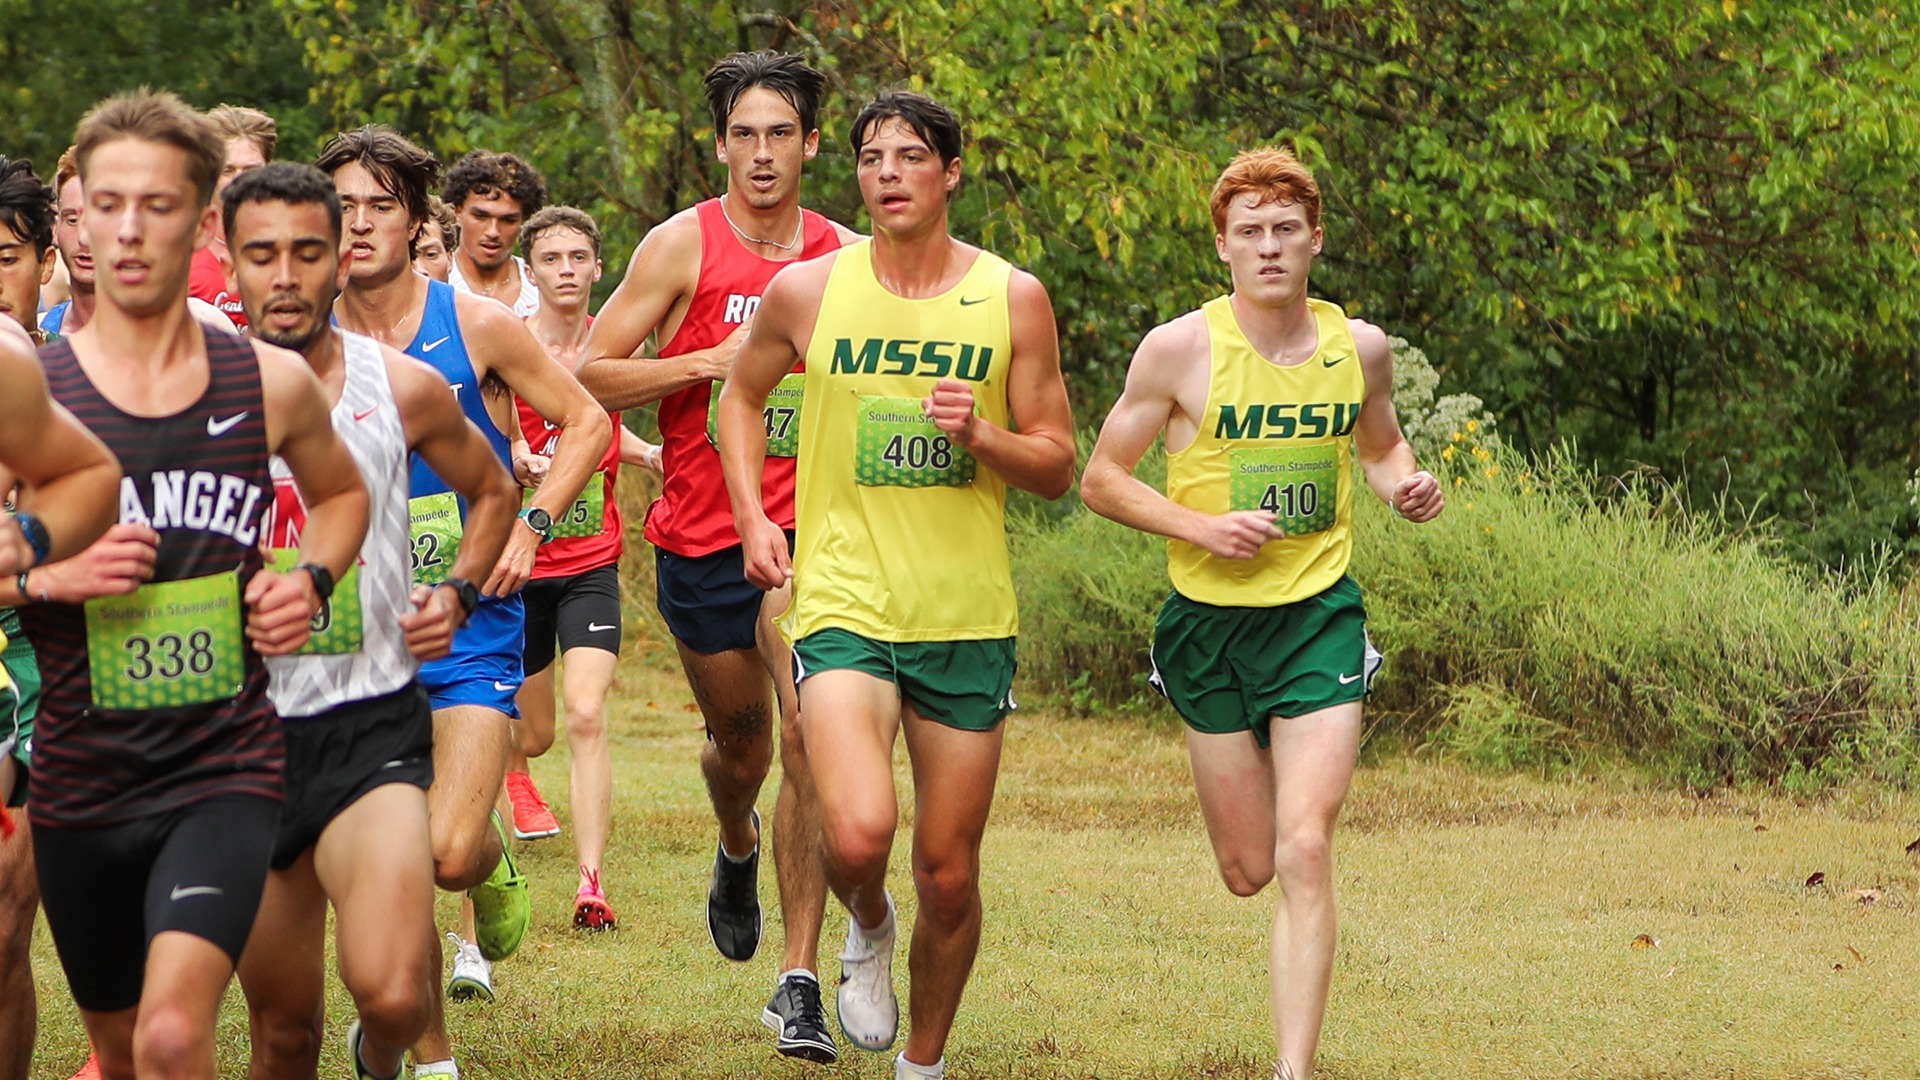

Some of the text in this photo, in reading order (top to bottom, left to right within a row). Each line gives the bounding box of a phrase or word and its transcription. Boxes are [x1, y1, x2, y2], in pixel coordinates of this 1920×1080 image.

[829, 337, 994, 382] MSSU
[868, 410, 915, 424] Southern
[1214, 402, 1360, 440] MSSU
[882, 434, 953, 470] 408
[1240, 460, 1333, 474] Southern Stampede
[1259, 481, 1318, 517] 410
[124, 626, 215, 684] 338
